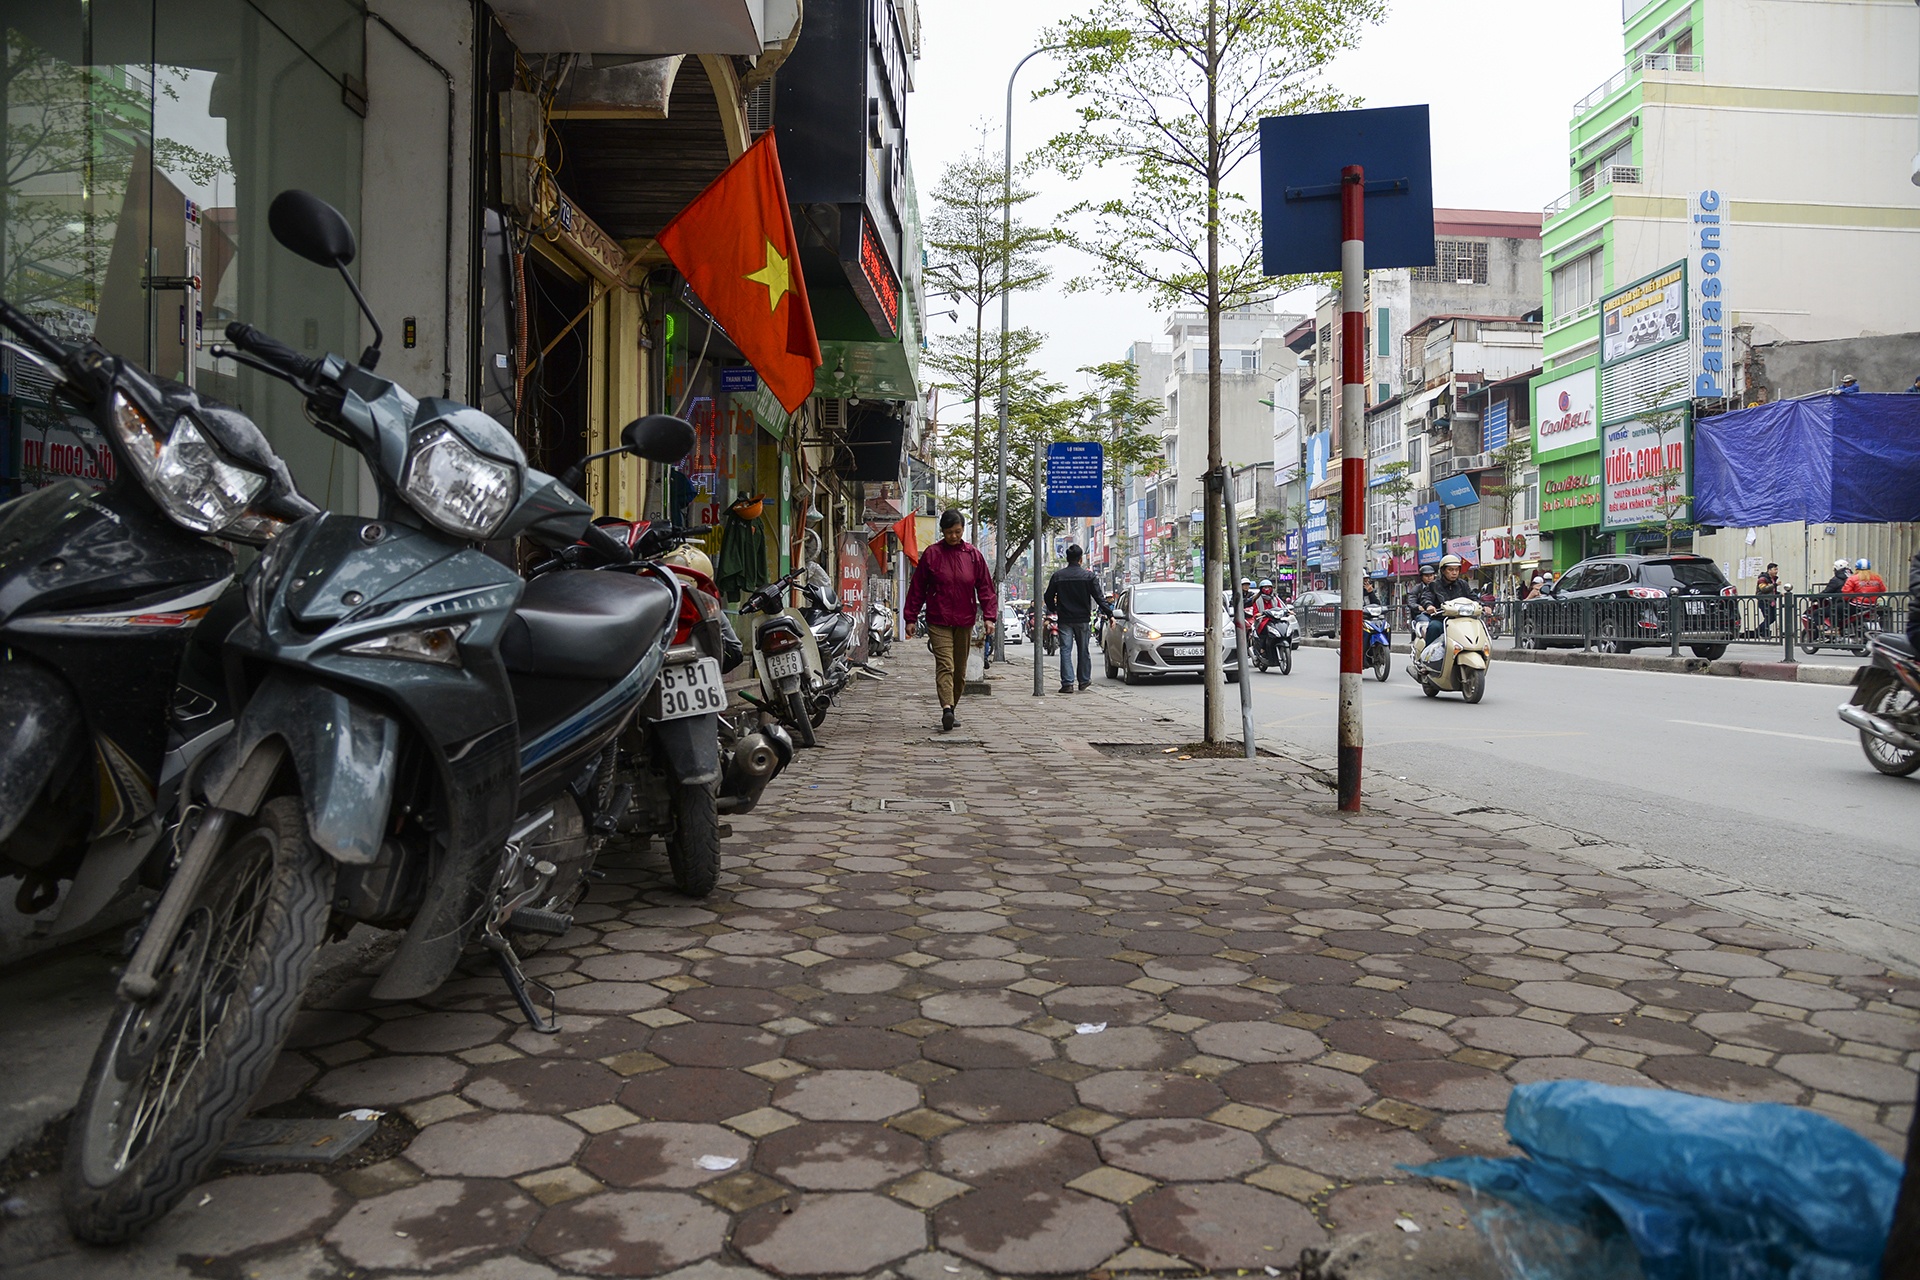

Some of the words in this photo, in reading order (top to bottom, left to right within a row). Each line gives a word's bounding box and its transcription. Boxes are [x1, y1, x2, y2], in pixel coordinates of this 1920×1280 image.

[1696, 189, 1722, 398] Panasonic
[1605, 442, 1683, 486] vidic.com.vn
[1417, 520, 1440, 550] BÉO
[844, 563, 860, 579] BẢO
[843, 583, 864, 602] HIỂM
[426, 595, 498, 615] SIRIUS
[770, 653, 797, 668] 29-F6
[774, 663, 798, 678] 6519
[663, 686, 721, 714] 30.96
